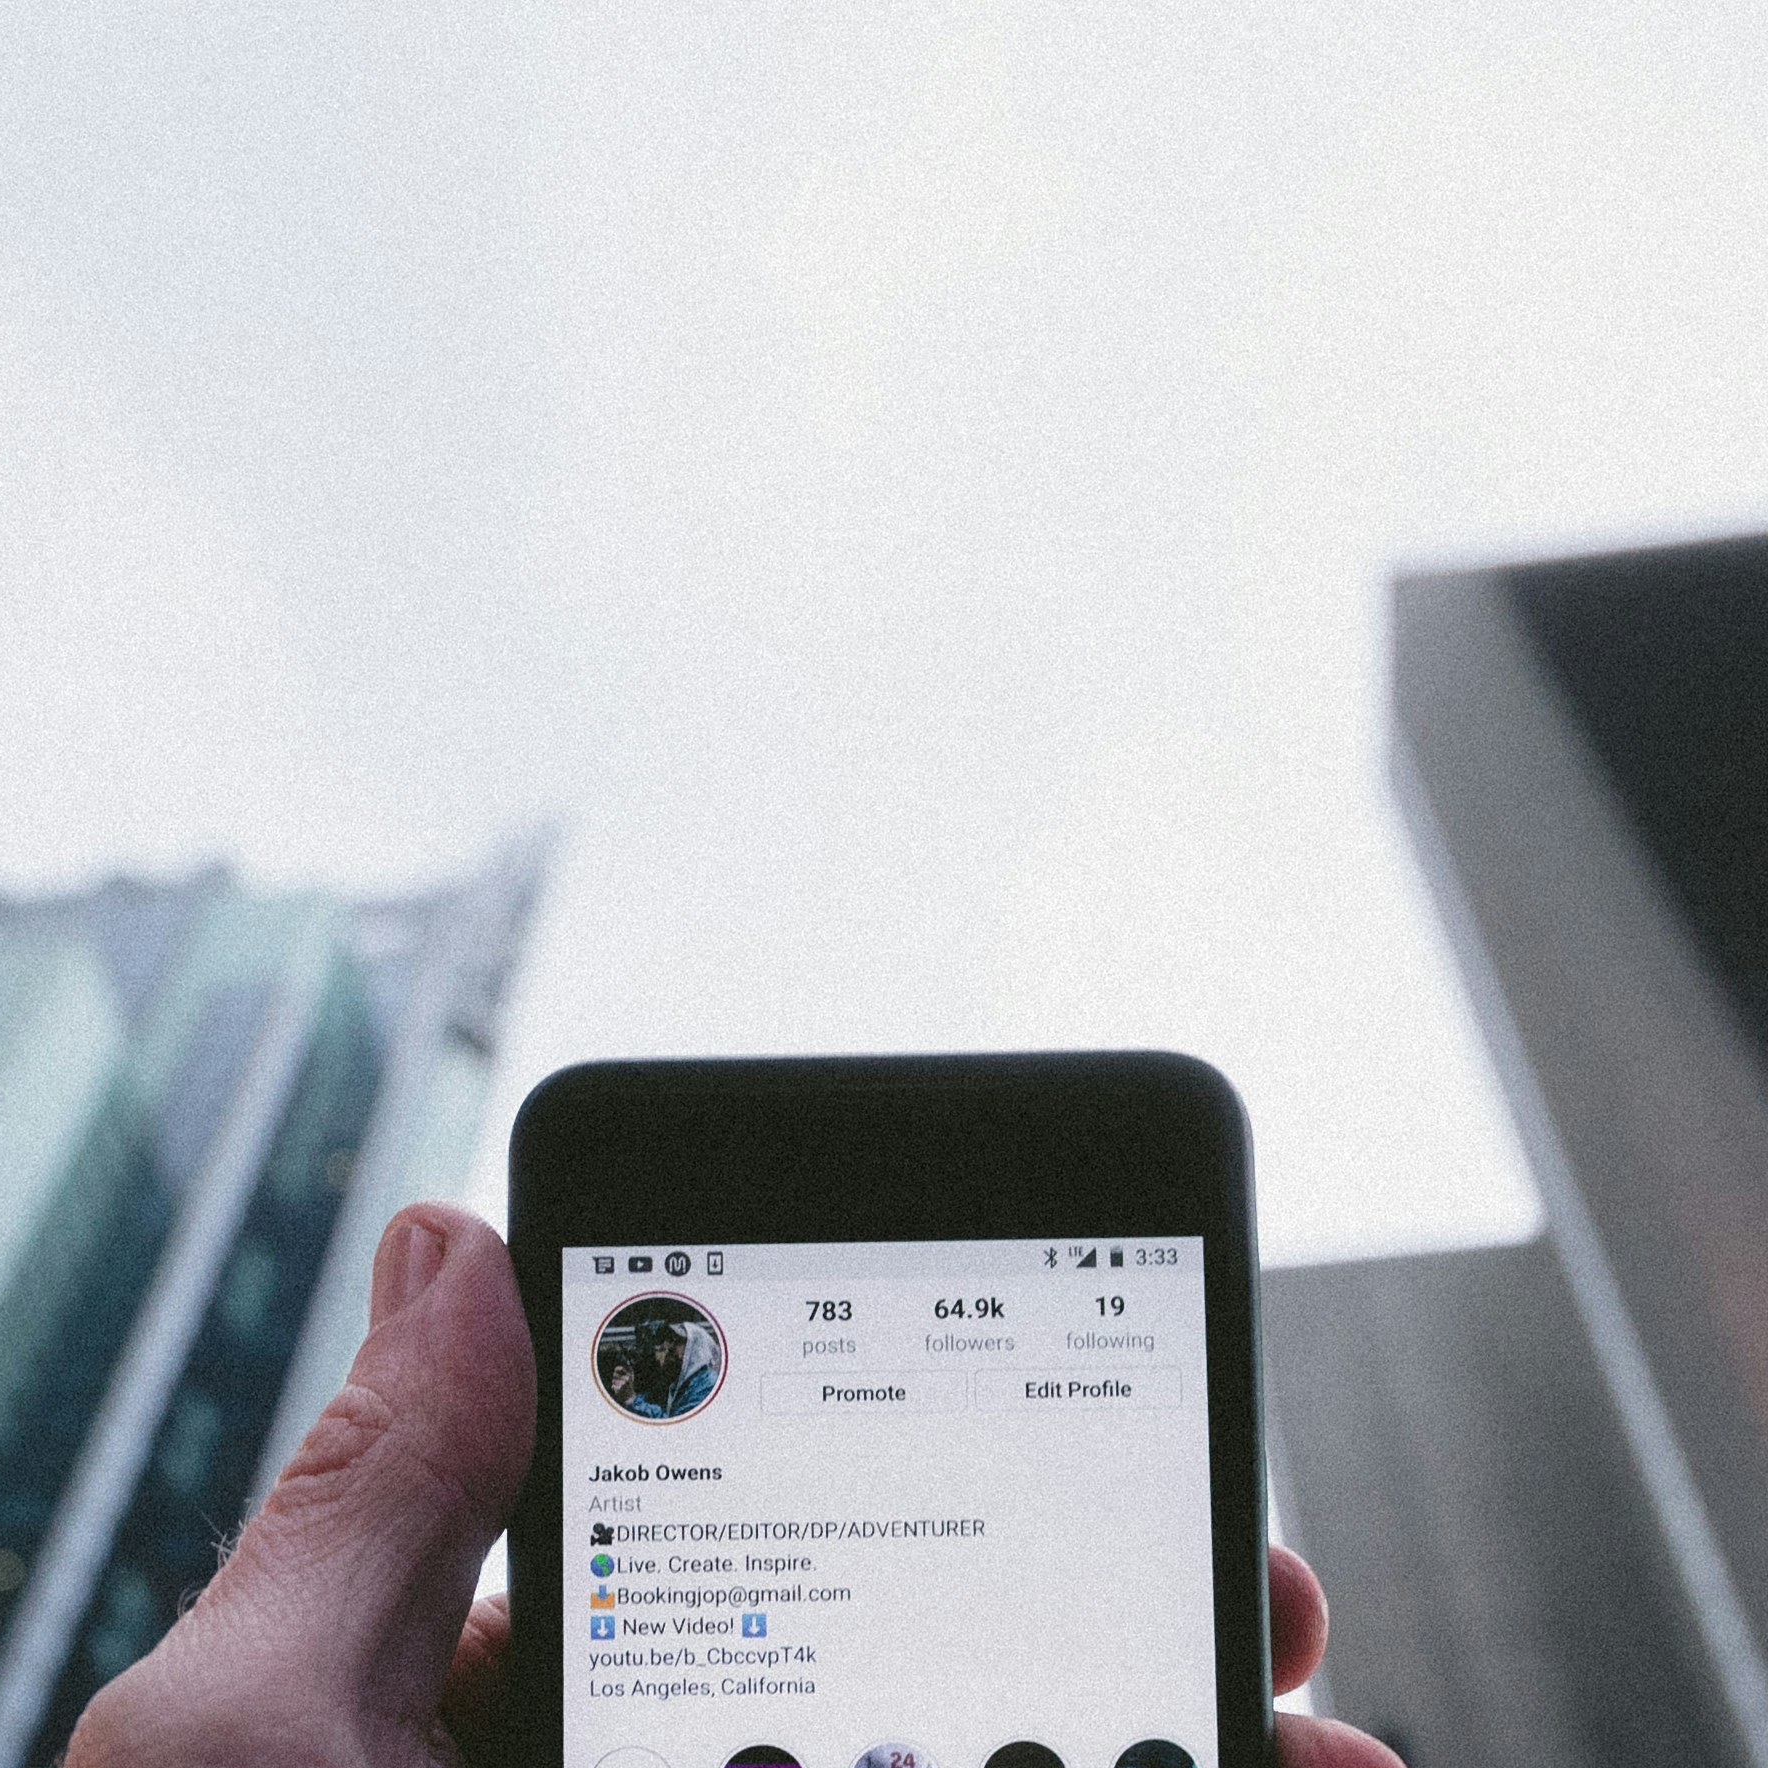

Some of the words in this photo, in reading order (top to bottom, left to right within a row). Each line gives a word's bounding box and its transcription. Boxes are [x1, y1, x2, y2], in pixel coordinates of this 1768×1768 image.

[1135, 1248, 1178, 1266] 3:33
[805, 1300, 853, 1321] 783
[934, 1297, 1005, 1319] 64.9k
[1095, 1295, 1125, 1317] 19
[802, 1337, 857, 1358] posts
[925, 1334, 1016, 1352] followers
[1066, 1331, 1155, 1353] following
[821, 1384, 907, 1402] Promote
[1025, 1381, 1063, 1399] Edit
[1068, 1379, 1132, 1398] Profile
[588, 1464, 650, 1482] Jakob
[655, 1464, 723, 1481] Owens
[588, 1495, 642, 1513] Artist
[616, 1519, 985, 1543] DIRECTOR/EDITOR/DP/ADVENTURER
[617, 1556, 662, 1574] Live.
[668, 1555, 738, 1574] Create.
[745, 1554, 818, 1576] Inspire.
[617, 1585, 851, 1608] Bookingjop@gmail.com
[622, 1618, 666, 1635] New
[672, 1617, 735, 1635] Video!
[589, 1646, 817, 1671] youtu.be/b_CbccvpT4k
[590, 1680, 625, 1697] Los
[632, 1678, 716, 1700] Angeles,
[721, 1677, 816, 1695] California
